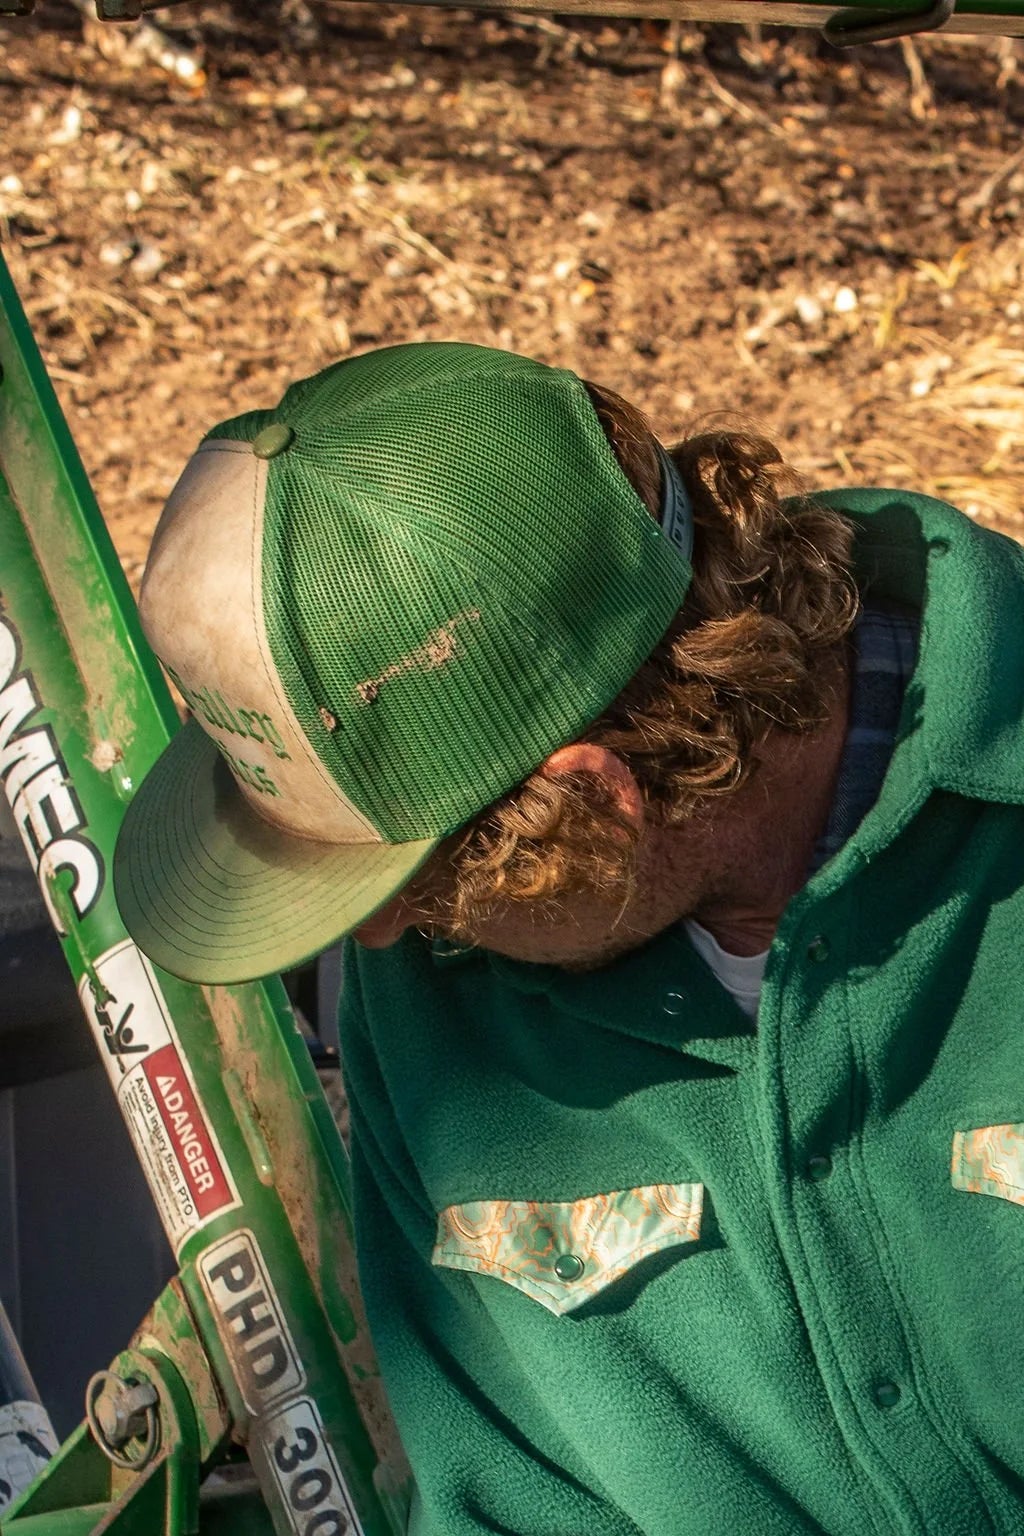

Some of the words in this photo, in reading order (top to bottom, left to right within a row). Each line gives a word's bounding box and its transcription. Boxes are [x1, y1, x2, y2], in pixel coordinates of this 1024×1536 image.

[135, 1077, 154, 1114] Avoid
[149, 1112, 168, 1151] injury
[165, 1152, 180, 1187] from
[178, 1187, 194, 1216] PTO
[164, 1091, 215, 1195] DANGER
[208, 1248, 289, 1391] PHD
